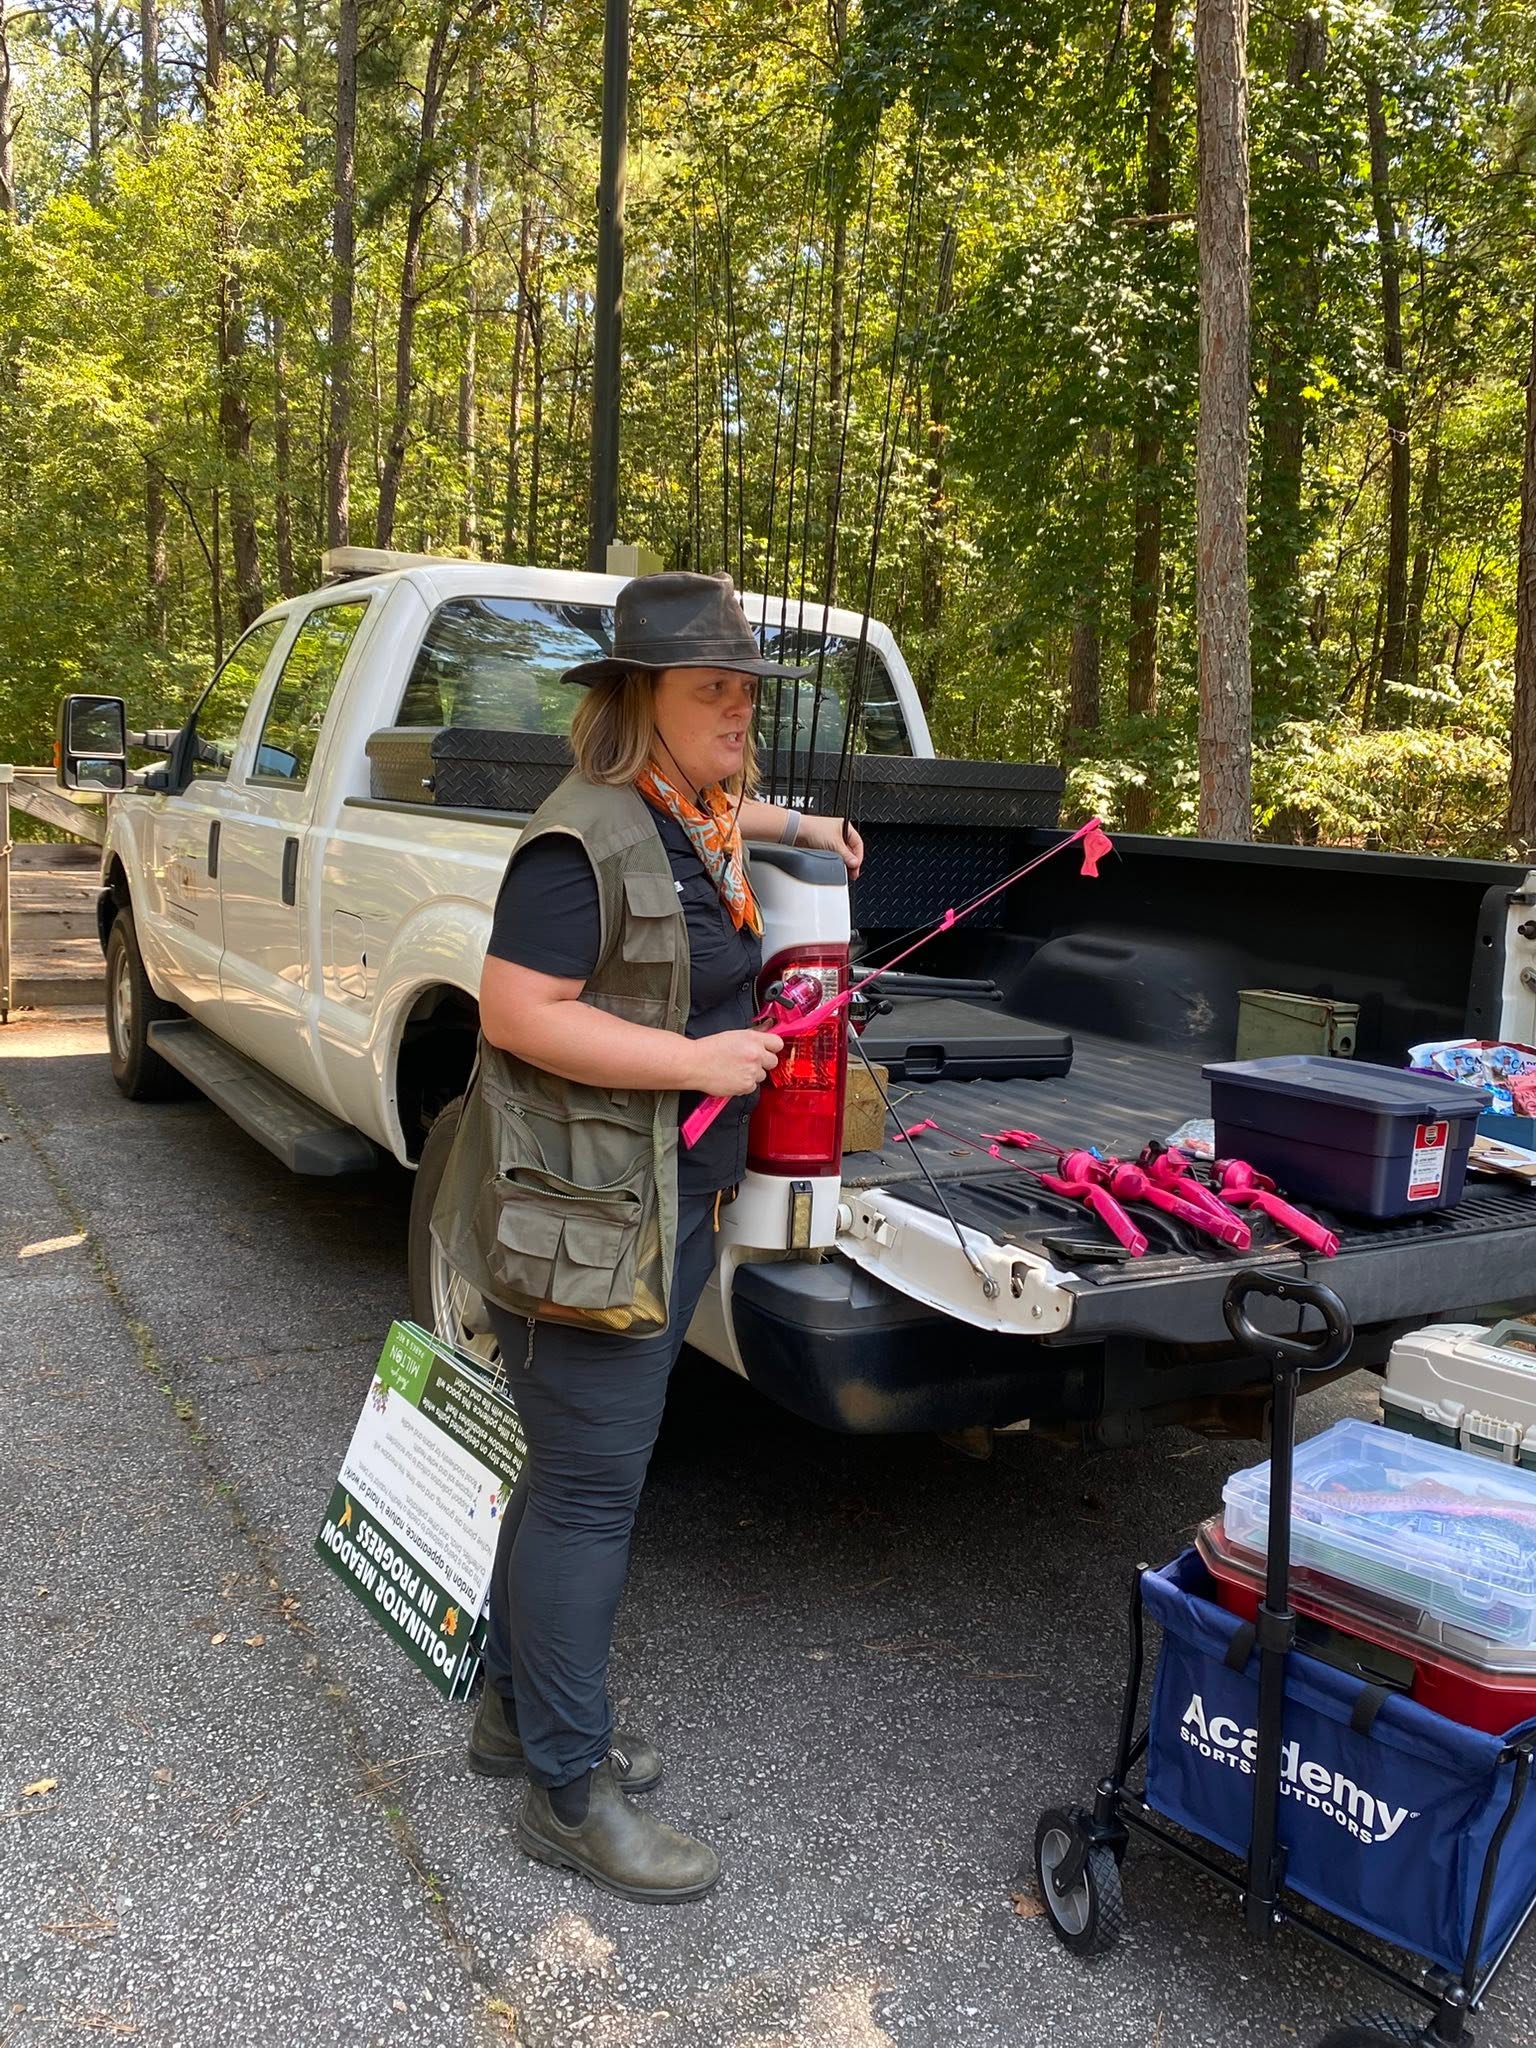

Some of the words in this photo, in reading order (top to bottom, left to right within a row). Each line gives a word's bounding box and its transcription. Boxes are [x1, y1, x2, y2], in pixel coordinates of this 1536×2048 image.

[395, 1330, 406, 1343] REC
[409, 1341, 425, 1358] PARKS
[389, 1343, 420, 1378] MILTON
[435, 1375, 446, 1390] will
[444, 1378, 463, 1401] space
[421, 1395, 435, 1414] while
[460, 1395, 472, 1411] this
[468, 1387, 482, 1405] and
[480, 1396, 491, 1411] life
[434, 1404, 451, 1426] paths
[443, 1400, 458, 1419] itself.
[470, 1401, 498, 1431] patience,
[490, 1403, 503, 1420] with
[448, 1414, 481, 1450] designated
[457, 1410, 488, 1442] establishes
[496, 1423, 510, 1441] little
[501, 1412, 518, 1432] burst
[486, 1434, 512, 1462] meadow
[509, 1432, 515, 1443] a
[513, 1436, 527, 1455] With
[478, 1442, 488, 1455] on
[486, 1446, 500, 1467] stay
[498, 1459, 518, 1483] Please
[511, 1454, 522, 1471] the
[343, 1465, 360, 1487] work!
[358, 1480, 366, 1494] at
[364, 1486, 380, 1508] hard
[378, 1499, 385, 1513] is
[383, 1505, 405, 1532] nature
[319, 1517, 378, 1593] MEADOW
[403, 1522, 445, 1570] appearance,
[354, 1517, 421, 1600] PROGRESS
[443, 1564, 452, 1581] its
[451, 1572, 477, 1605] Pardon
[417, 1582, 438, 1619] IN
[373, 1575, 457, 1679] POLLINATOR
[1182, 1694, 1409, 1842] Academy
[1280, 1781, 1374, 1844] UTDOORS
